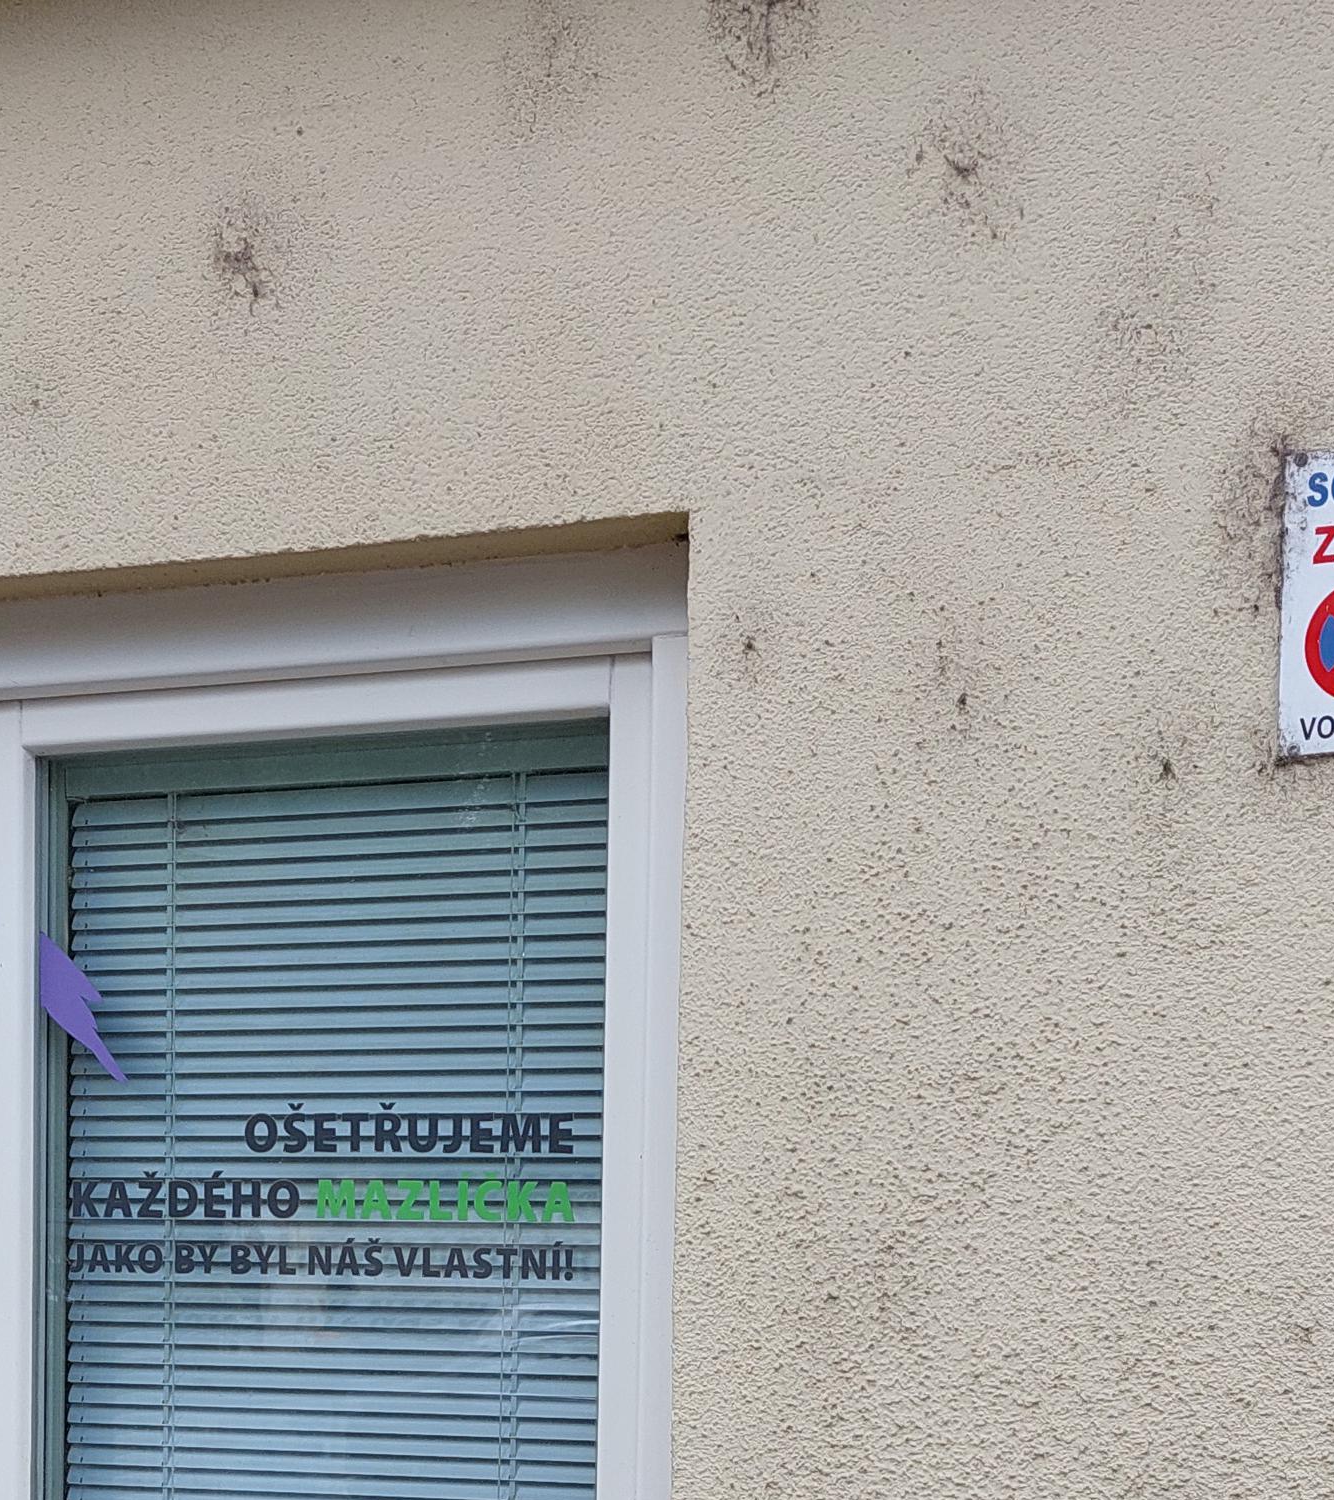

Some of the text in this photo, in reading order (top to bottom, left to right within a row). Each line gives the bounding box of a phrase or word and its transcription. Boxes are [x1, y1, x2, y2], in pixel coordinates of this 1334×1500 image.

[245, 1103, 574, 1154] OŠETŘUJEME
[71, 1171, 575, 1222] KAŽDÉHO MAZLÍČKA
[70, 1238, 574, 1282] JAKO BY BYL NÁŠ VLASTNÍ!
